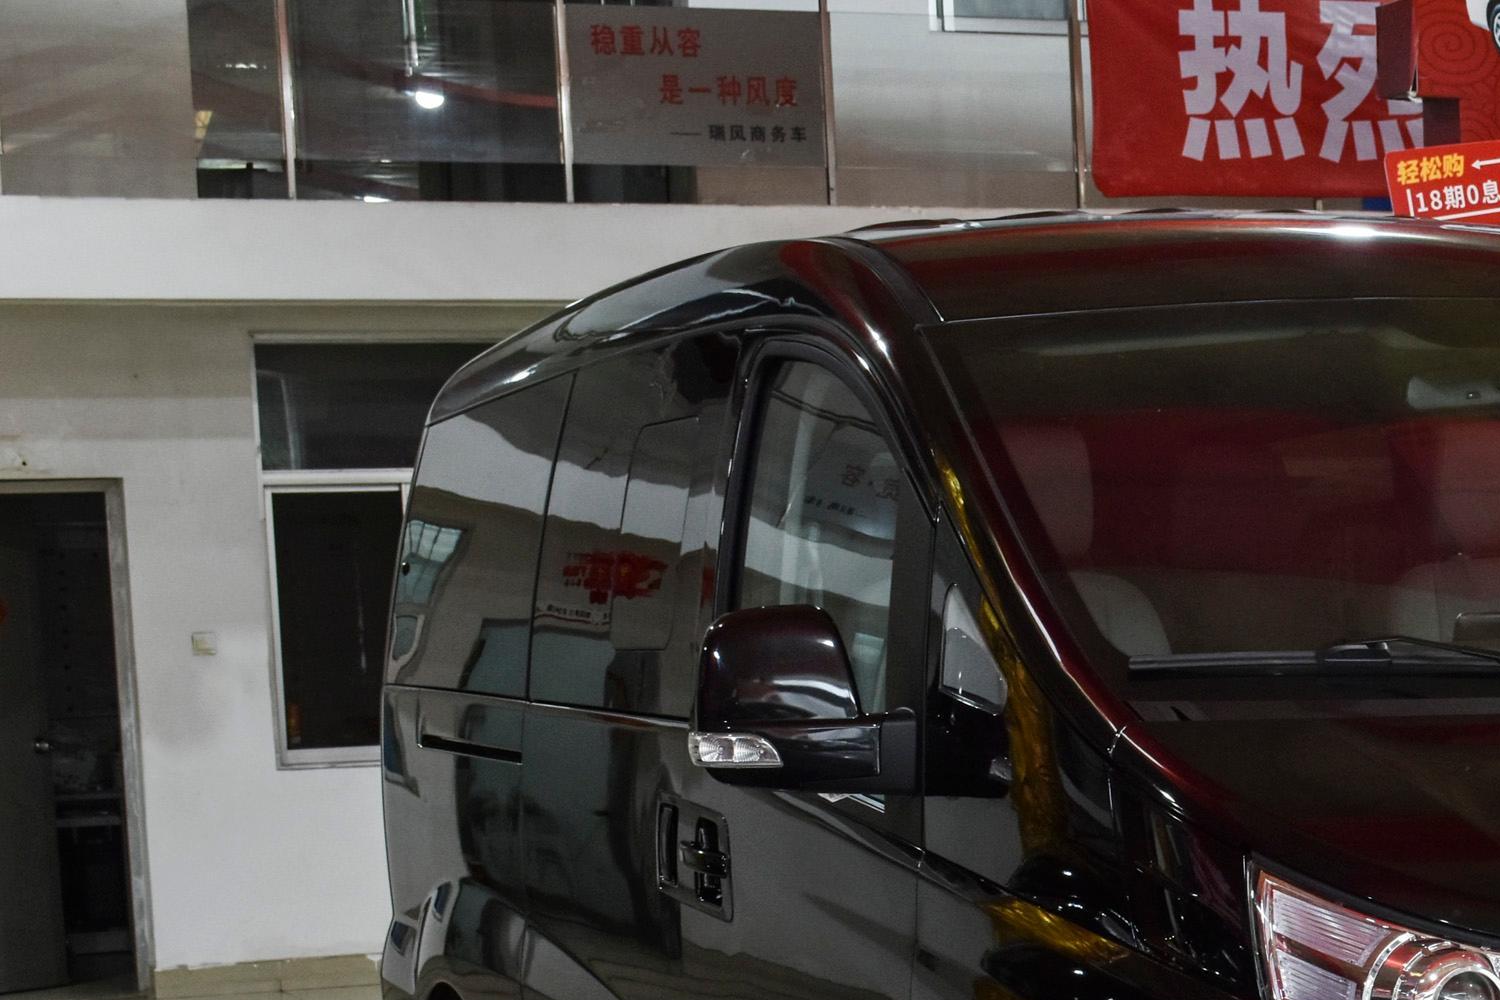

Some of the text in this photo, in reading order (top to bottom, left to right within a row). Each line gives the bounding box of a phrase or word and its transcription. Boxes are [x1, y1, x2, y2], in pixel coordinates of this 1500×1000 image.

[590, 24, 701, 58] 稳重从容
[659, 74, 798, 107] 是一种风度
[1397, 153, 1465, 186] 轻松购
